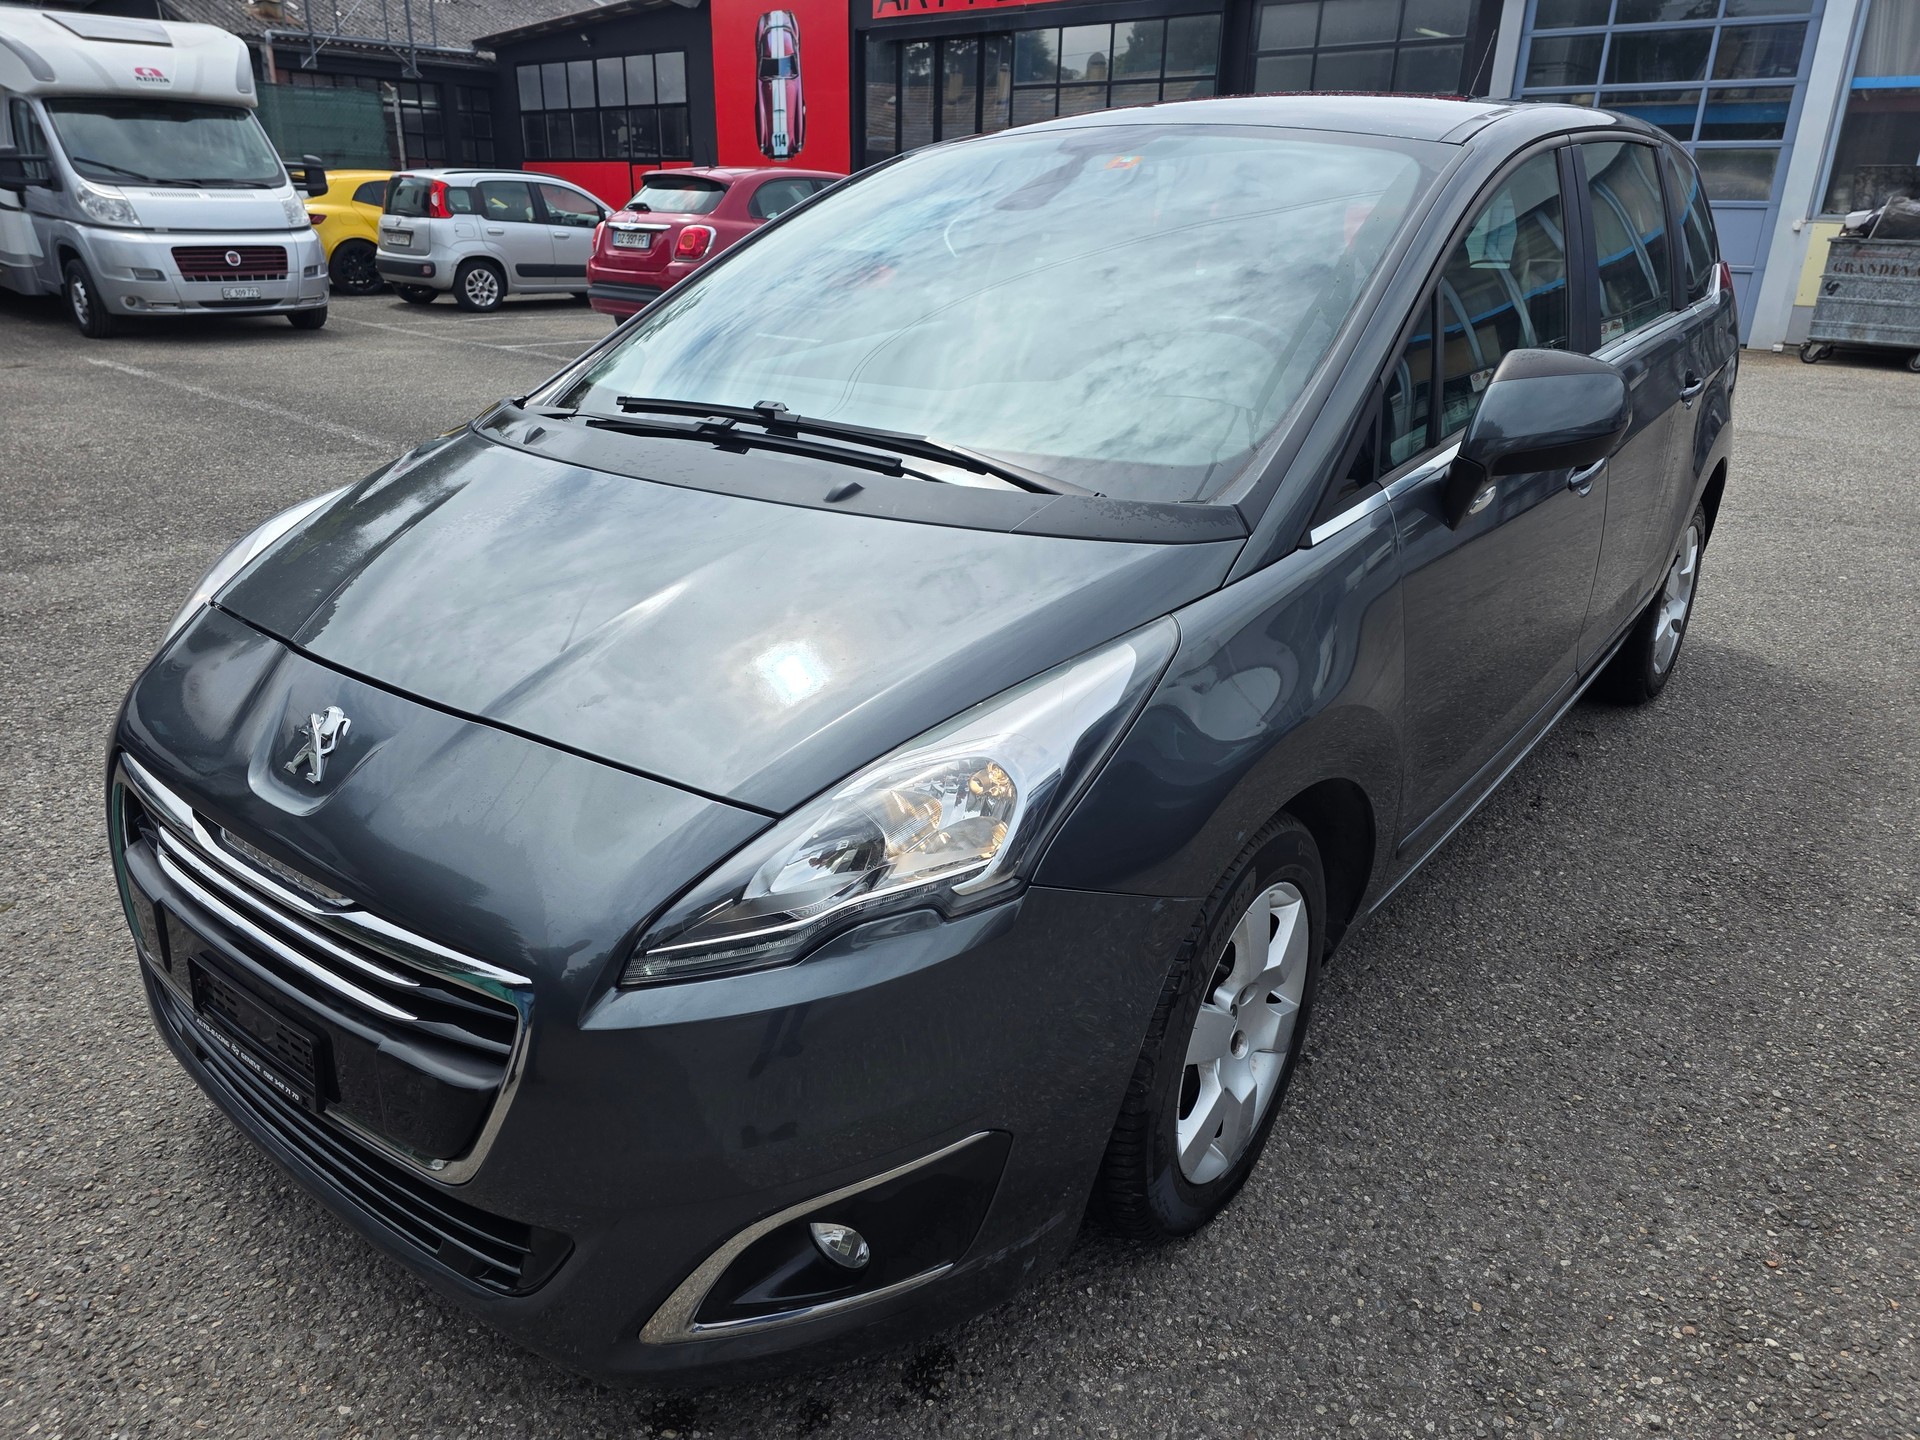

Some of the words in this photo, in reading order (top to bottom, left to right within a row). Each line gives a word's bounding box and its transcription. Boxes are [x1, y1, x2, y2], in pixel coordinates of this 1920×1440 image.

[774, 133, 787, 147] 114
[196, 1018, 230, 1048] AUTO-RACING
[262, 1070, 274, 1082] 022
[285, 1086, 291, 1095] 71
[291, 1091, 300, 1101] 70
